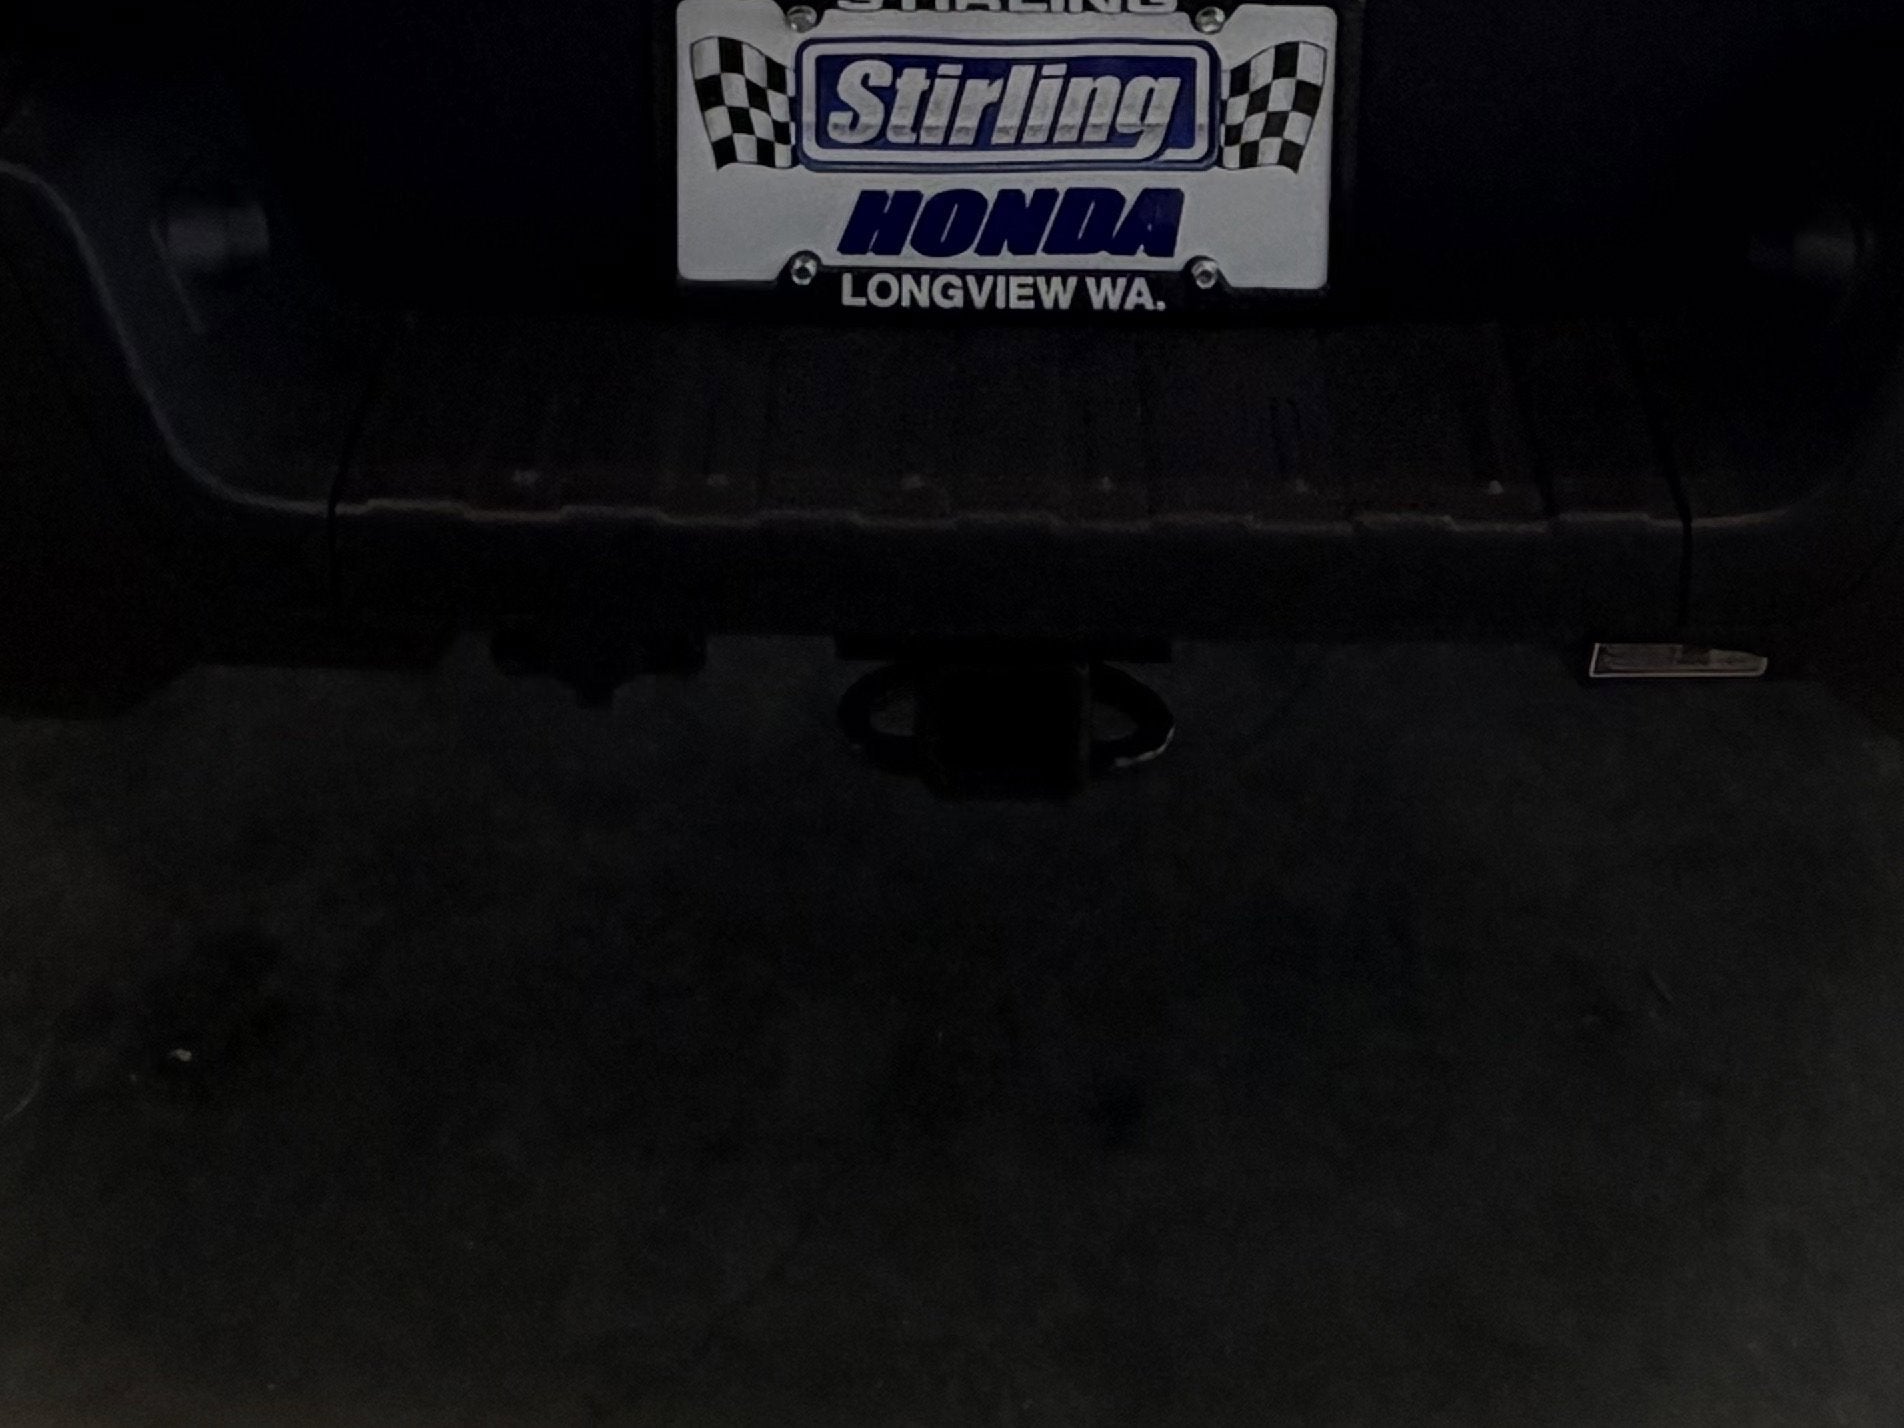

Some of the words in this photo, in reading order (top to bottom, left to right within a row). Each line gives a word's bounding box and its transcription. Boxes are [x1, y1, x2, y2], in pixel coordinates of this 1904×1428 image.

[828, 59, 1181, 161] Stirling
[837, 187, 1184, 257] HONDA
[842, 274, 1077, 309] LONGVIEW
[1086, 278, 1166, 310] WA.
